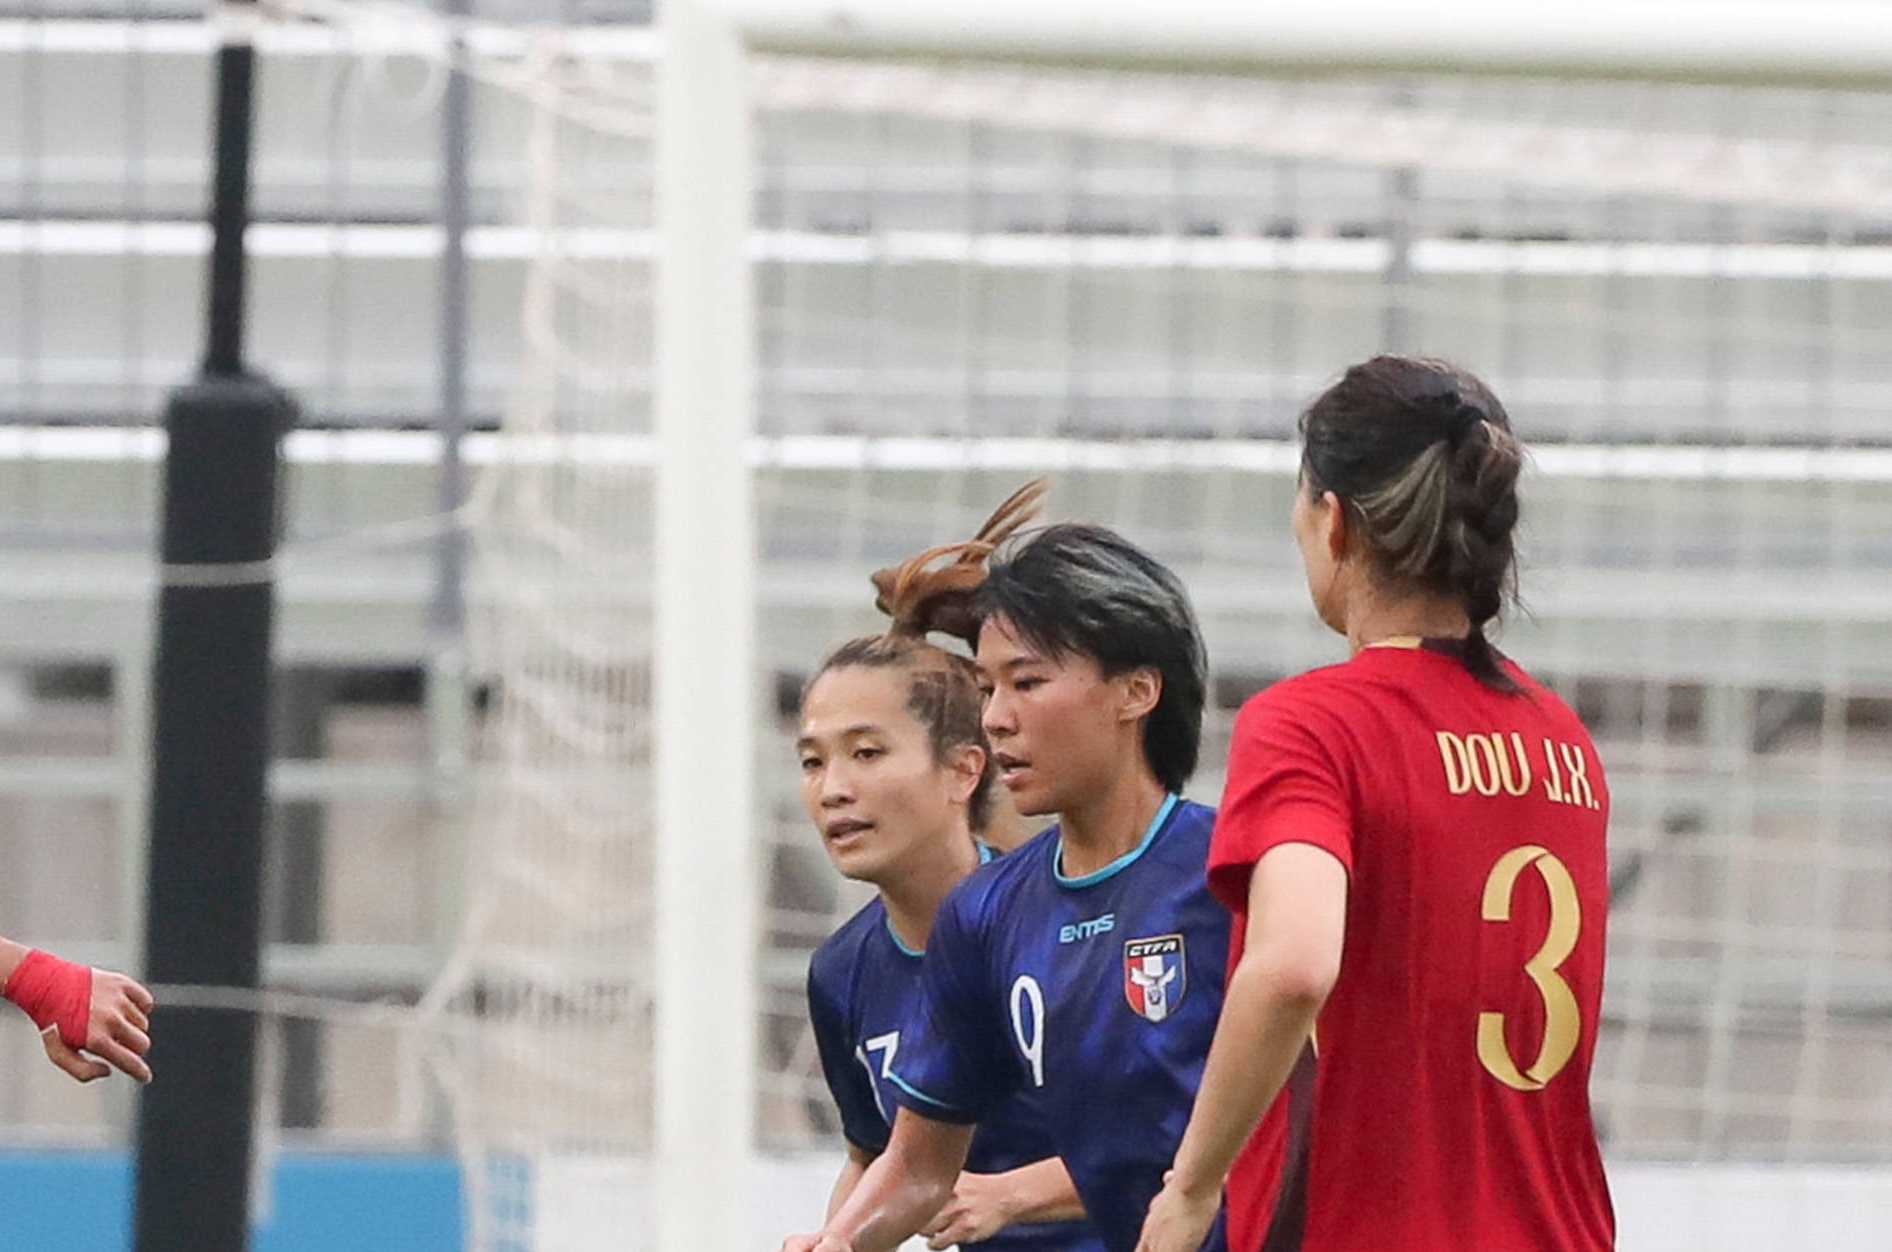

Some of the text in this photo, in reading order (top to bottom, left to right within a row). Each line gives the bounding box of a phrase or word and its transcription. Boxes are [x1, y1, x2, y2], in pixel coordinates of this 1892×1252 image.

[1436, 730, 1601, 812] DOU J.X.
[1476, 844, 1582, 1092] 3
[1009, 974, 1045, 1087] 9
